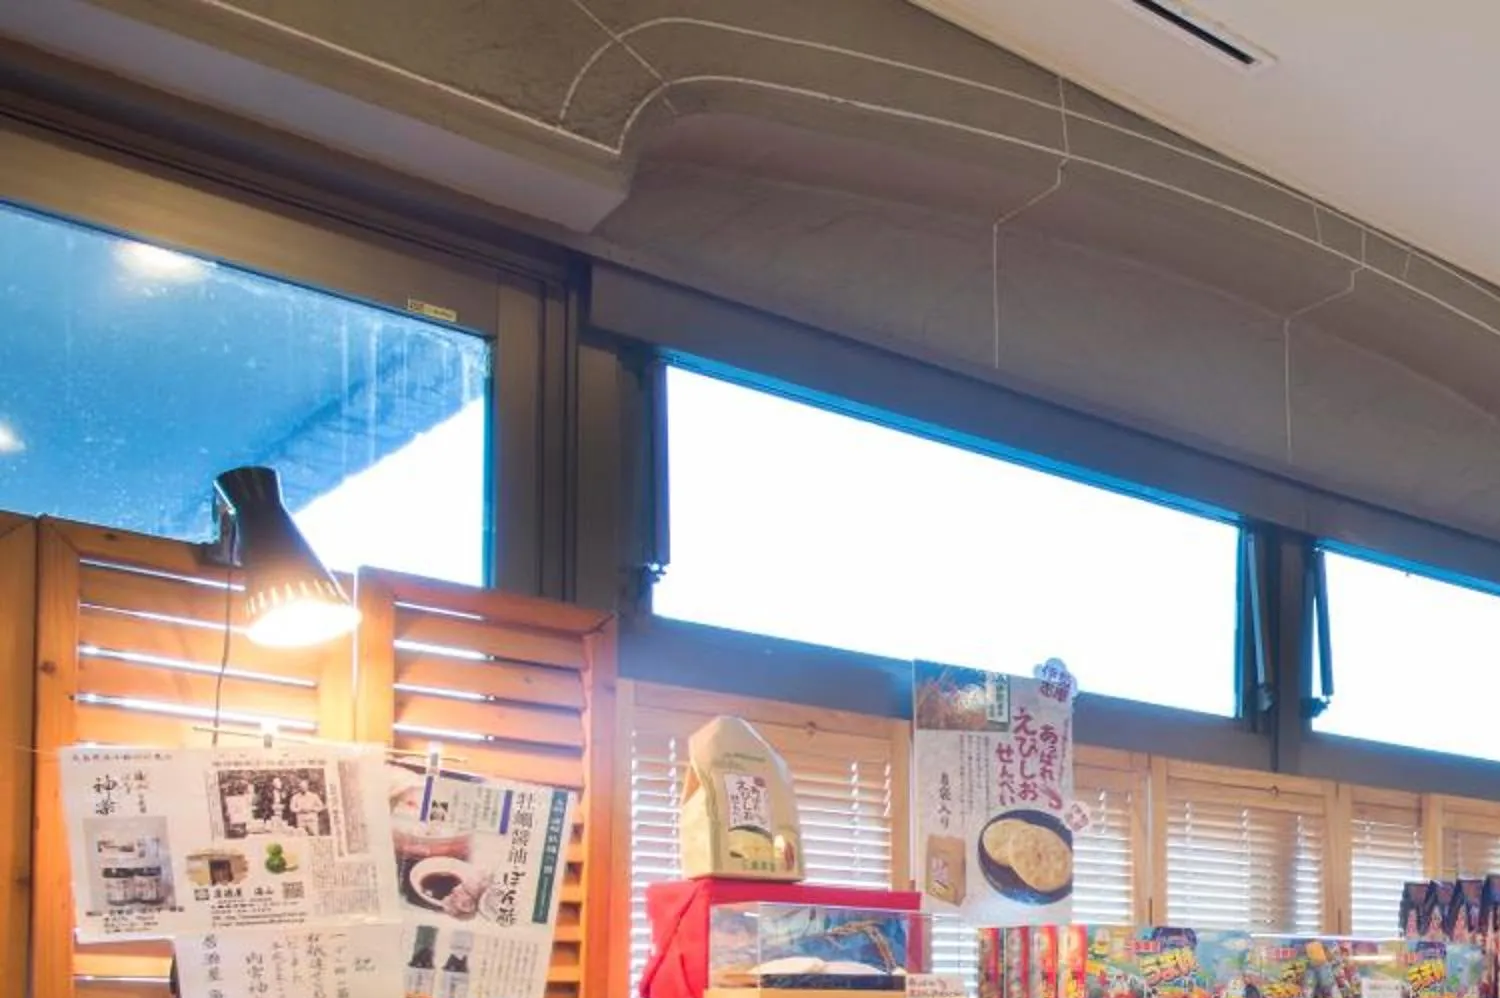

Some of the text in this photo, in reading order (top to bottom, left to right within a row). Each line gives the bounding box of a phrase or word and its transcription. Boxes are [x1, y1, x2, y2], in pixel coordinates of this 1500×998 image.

[996, 742, 1016, 806] せんべい
[1012, 707, 1039, 801] えびしお
